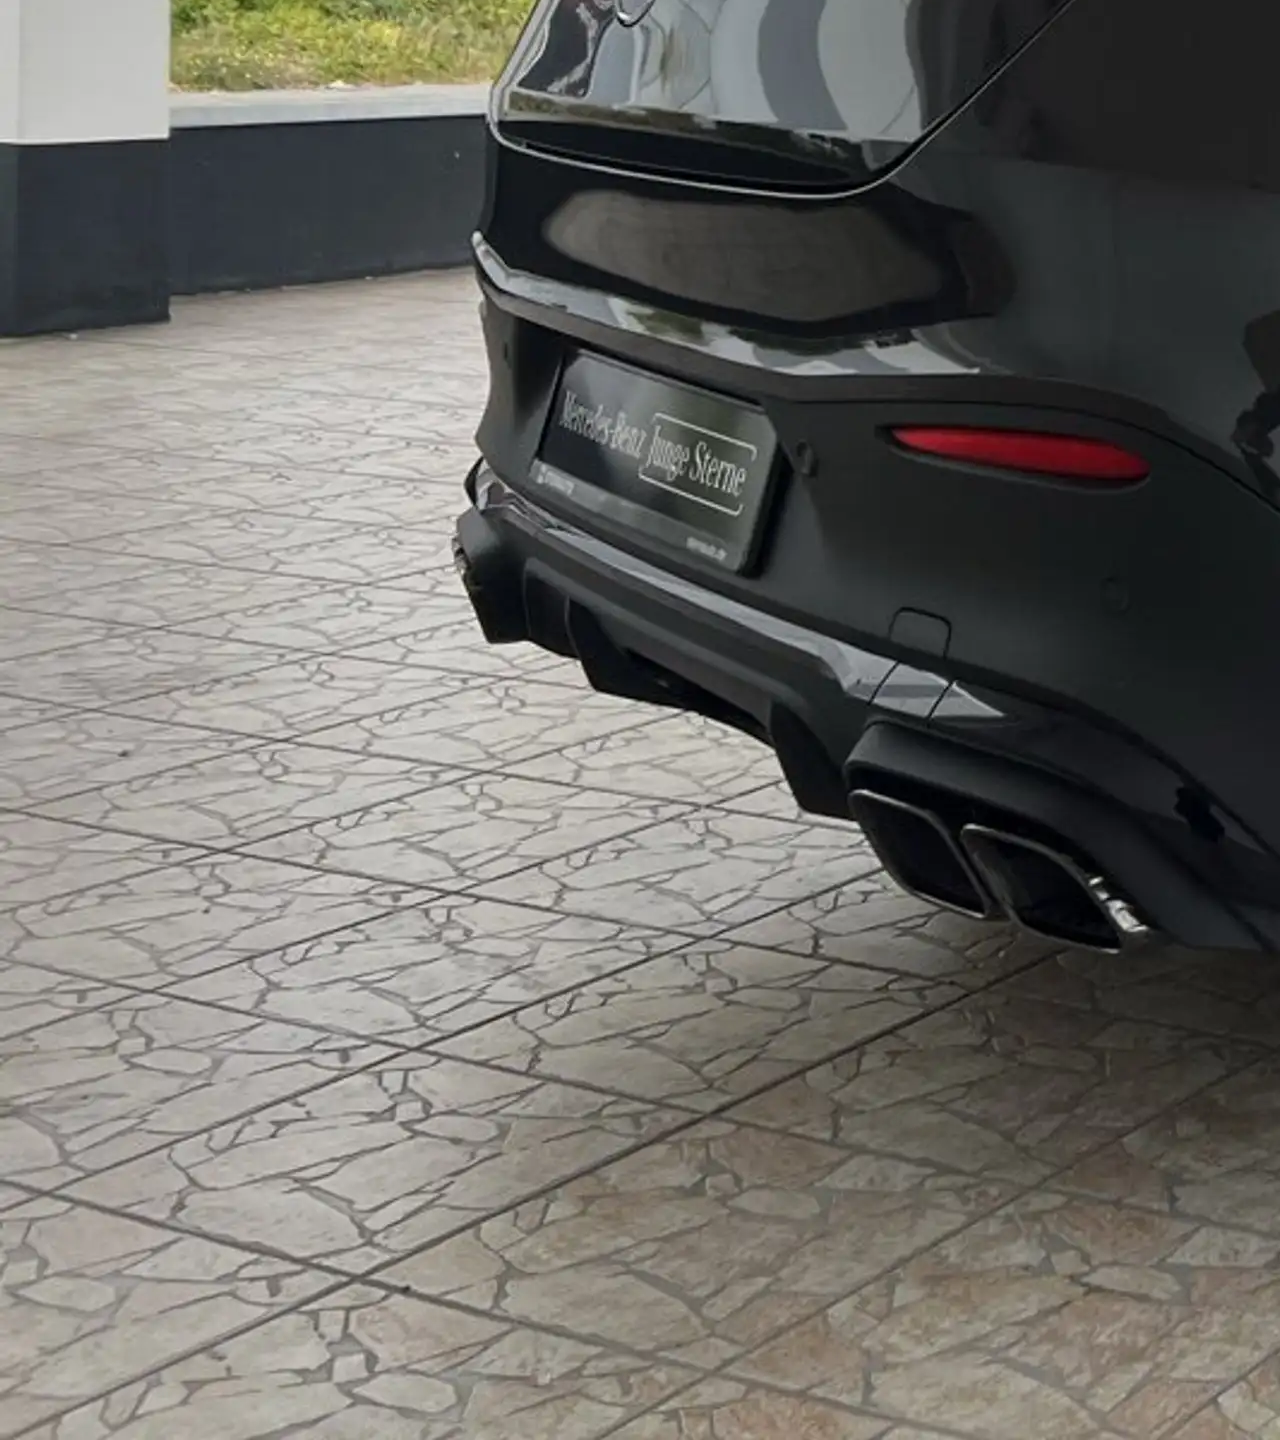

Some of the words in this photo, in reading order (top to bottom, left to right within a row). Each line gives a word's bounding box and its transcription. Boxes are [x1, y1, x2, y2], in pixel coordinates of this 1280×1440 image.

[559, 390, 647, 458] Mercedes-Benz
[645, 424, 690, 481] Junge
[688, 440, 747, 497] Sterne
